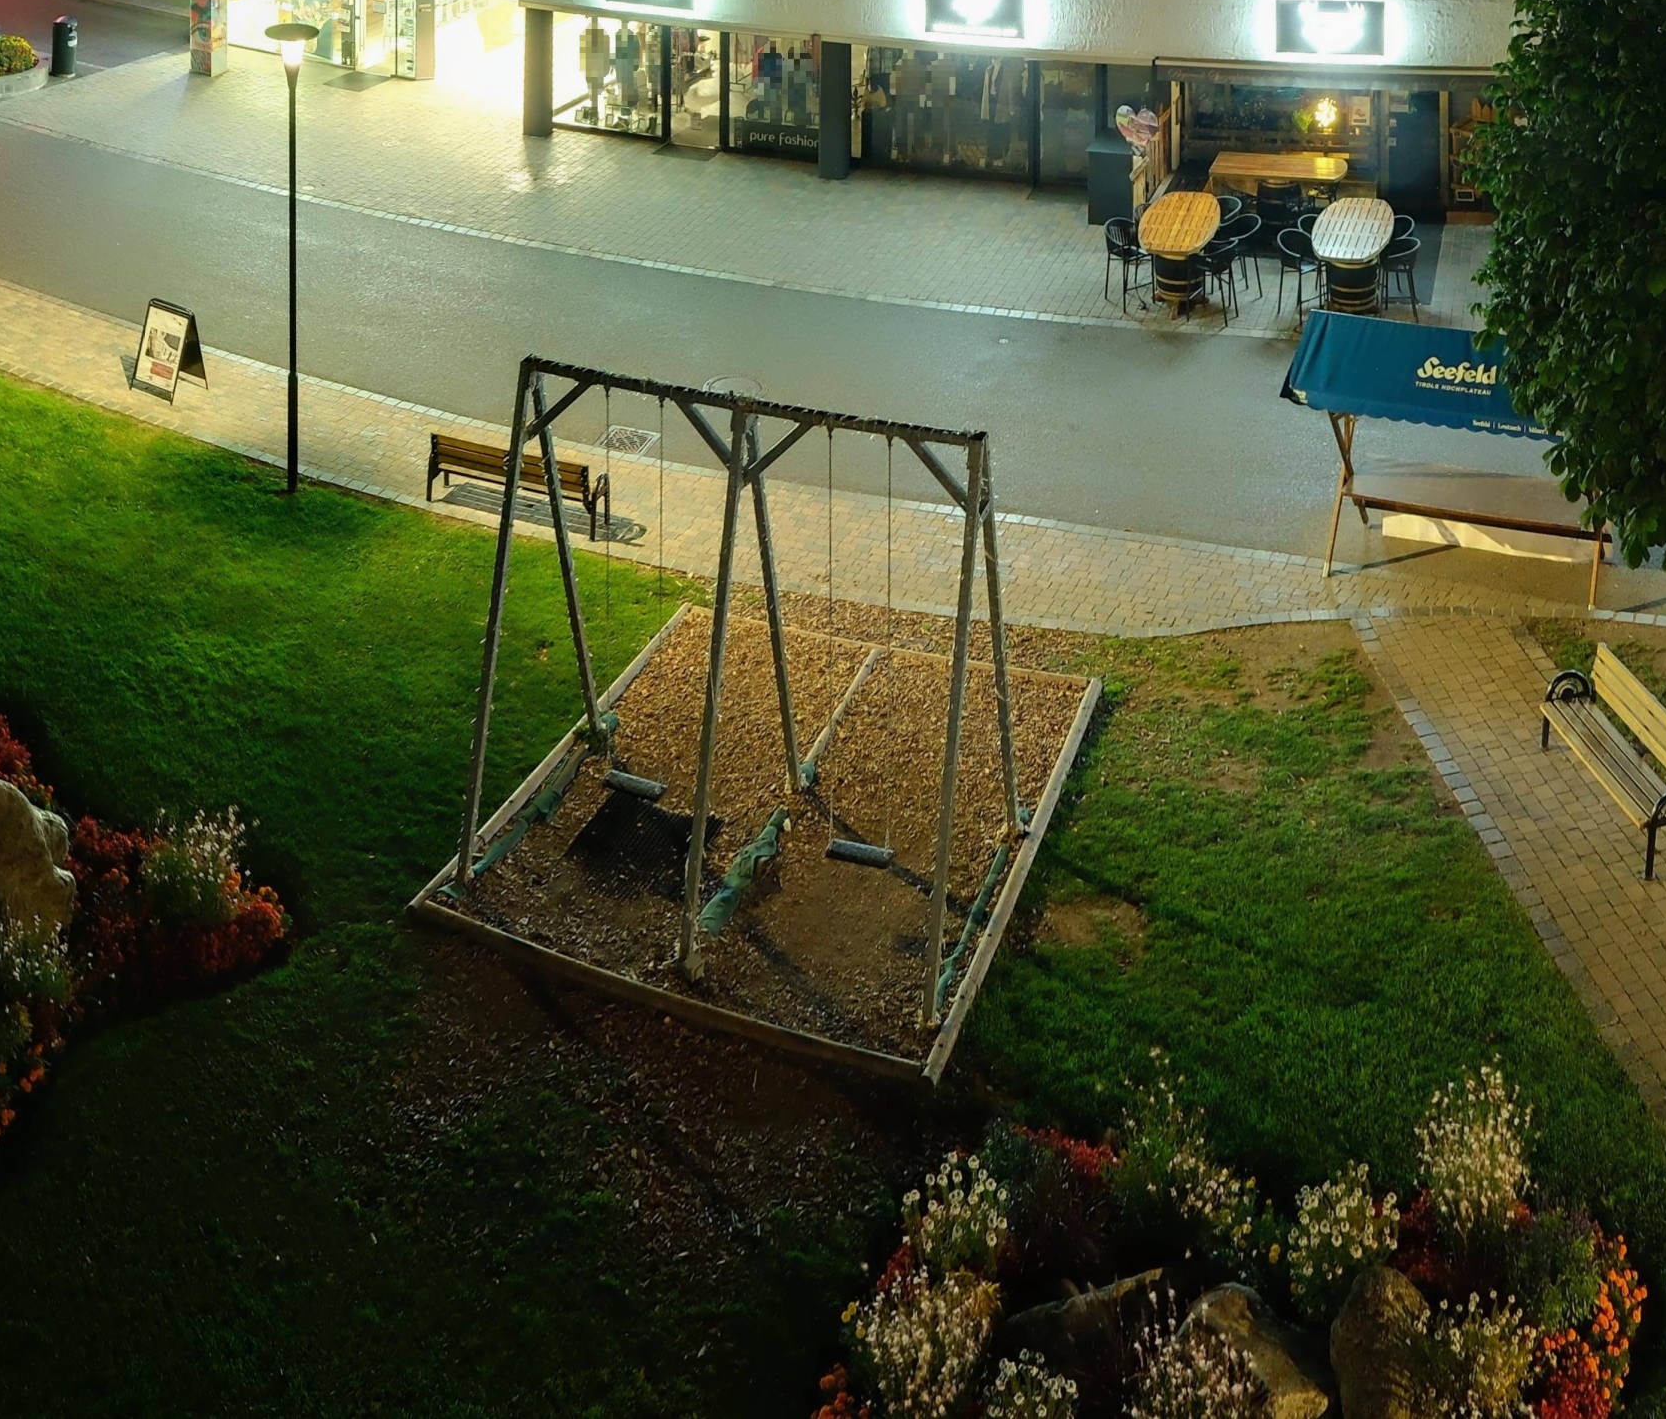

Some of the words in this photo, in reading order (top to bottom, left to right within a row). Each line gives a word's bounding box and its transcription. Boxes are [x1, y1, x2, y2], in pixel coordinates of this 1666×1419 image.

[749, 131, 775, 143] pure
[1416, 356, 1496, 384] Seefeld
[1415, 381, 1440, 390] TIROLS
[1441, 384, 1492, 396] HOCHPLATEAU
